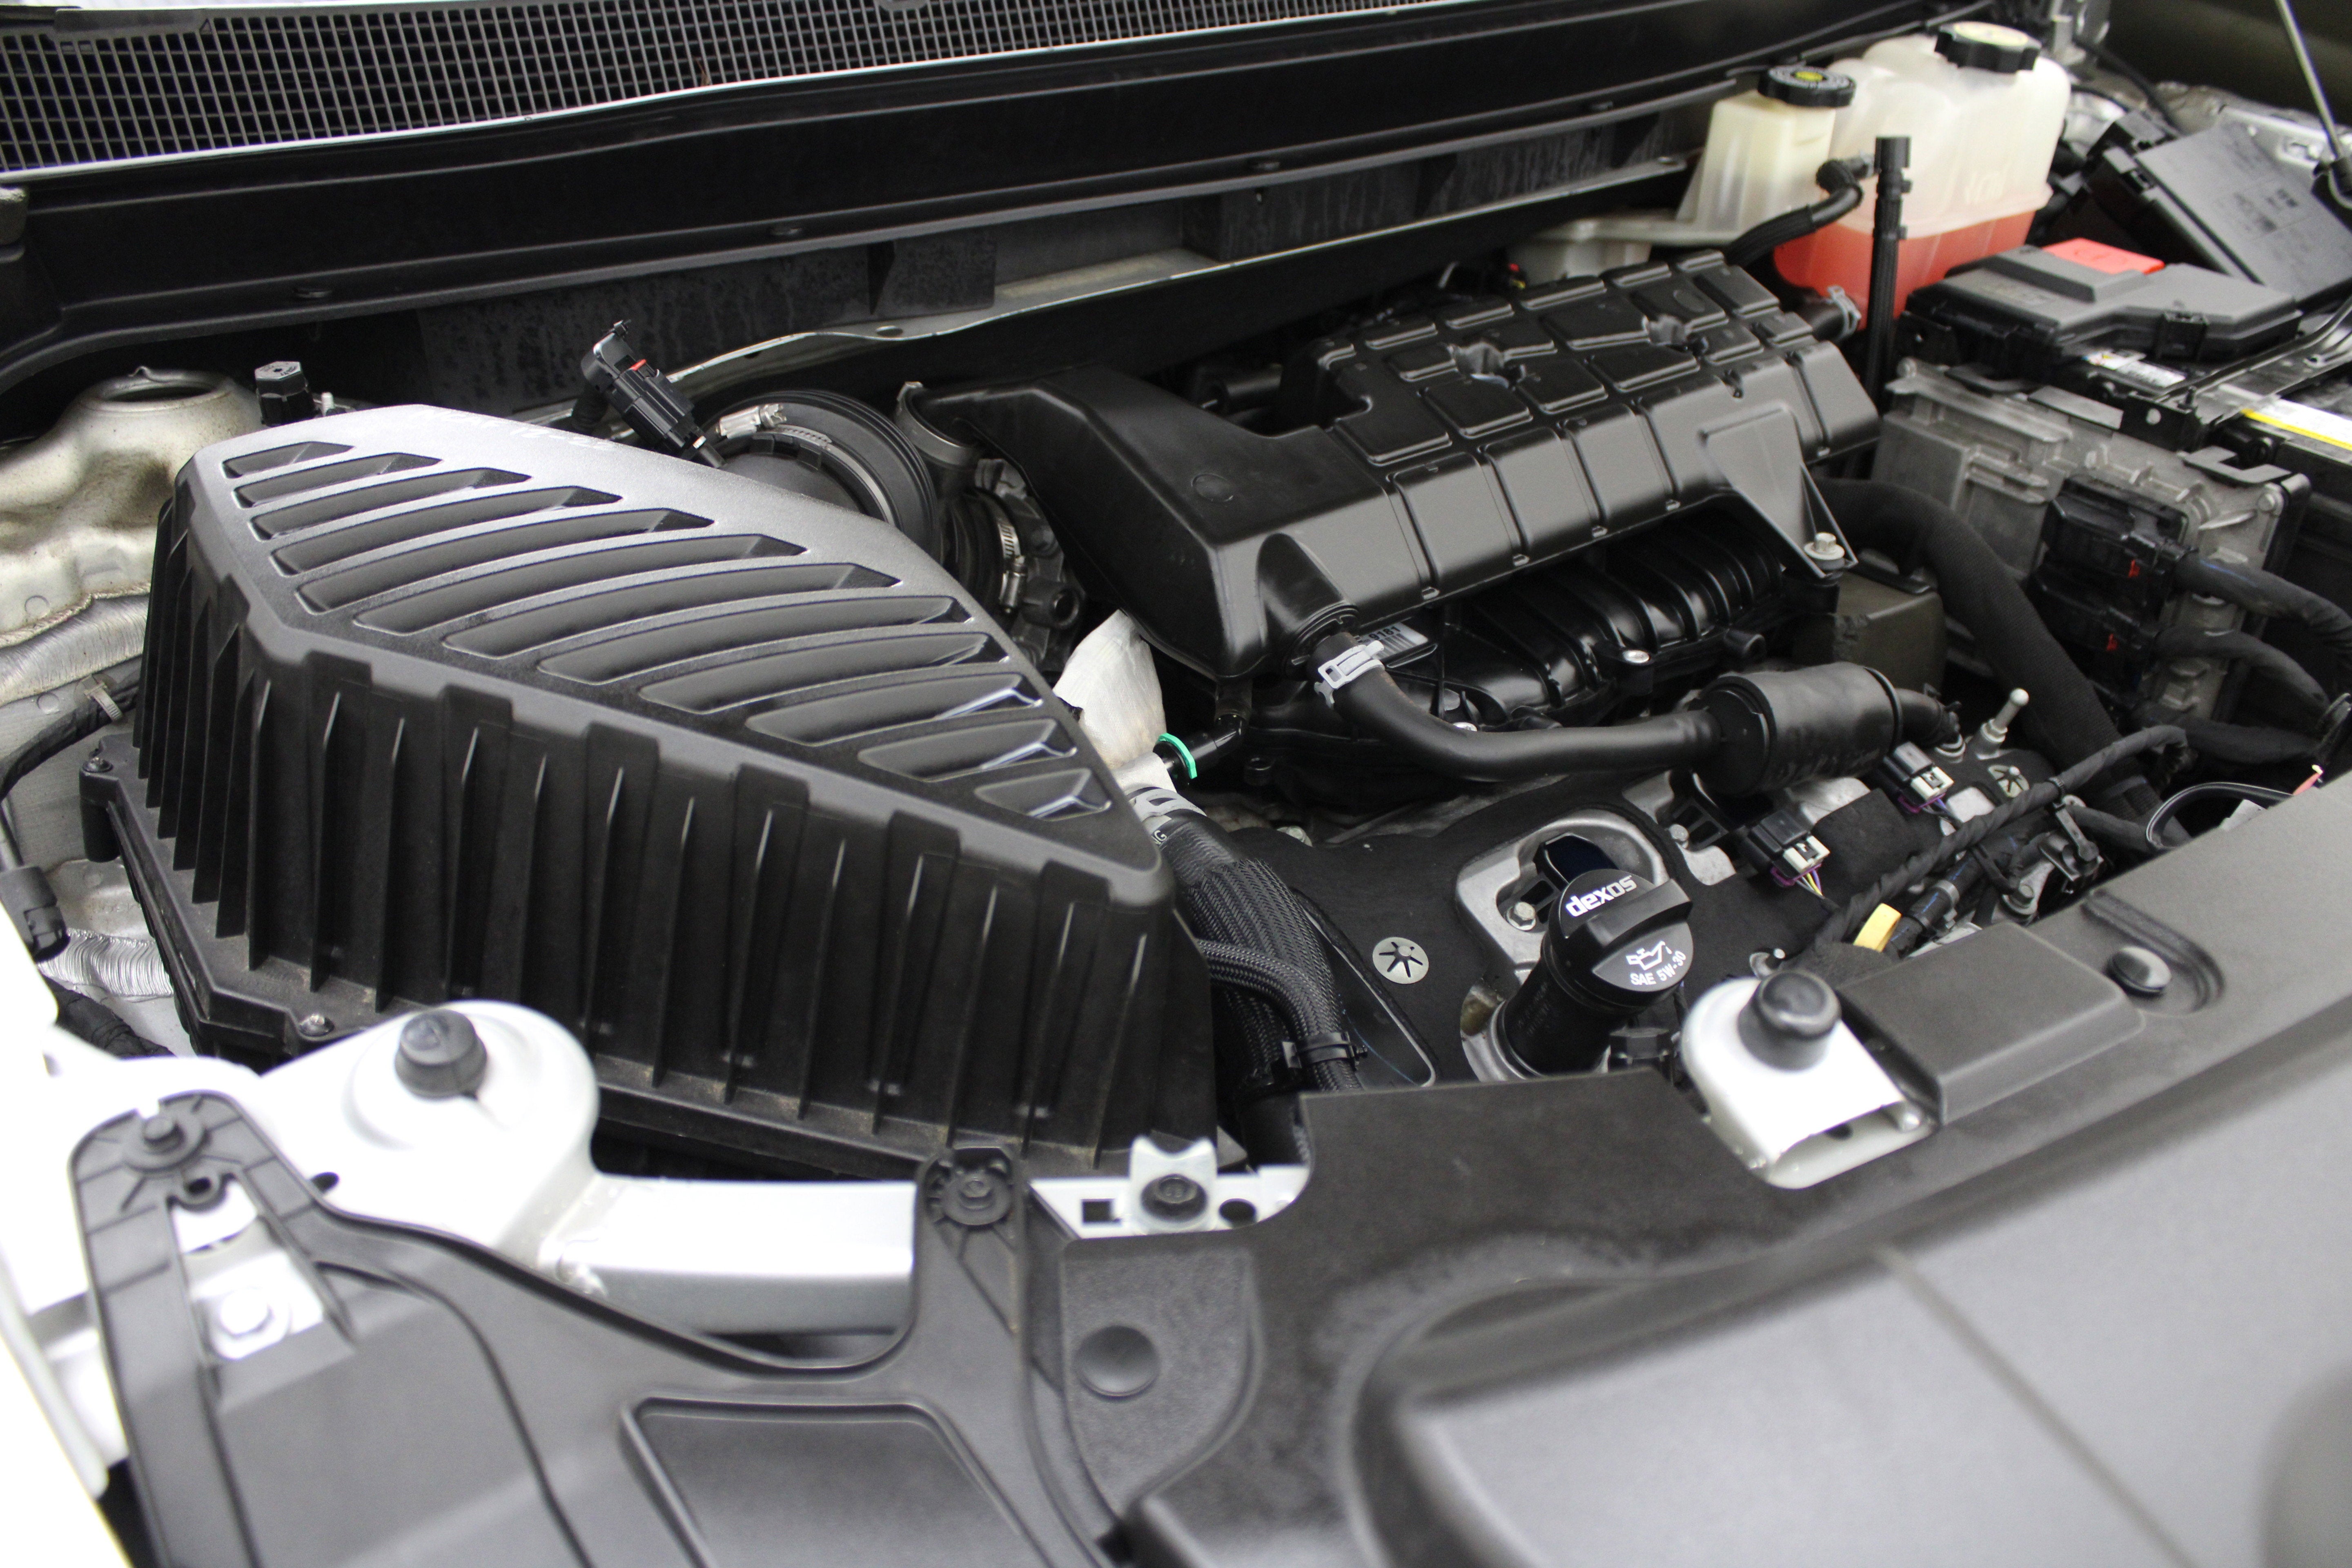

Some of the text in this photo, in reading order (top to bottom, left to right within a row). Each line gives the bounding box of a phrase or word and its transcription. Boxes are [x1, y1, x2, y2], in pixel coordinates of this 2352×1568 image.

[1566, 875, 1637, 917] dexos
[1630, 951, 1686, 985] SAE 5W-30
